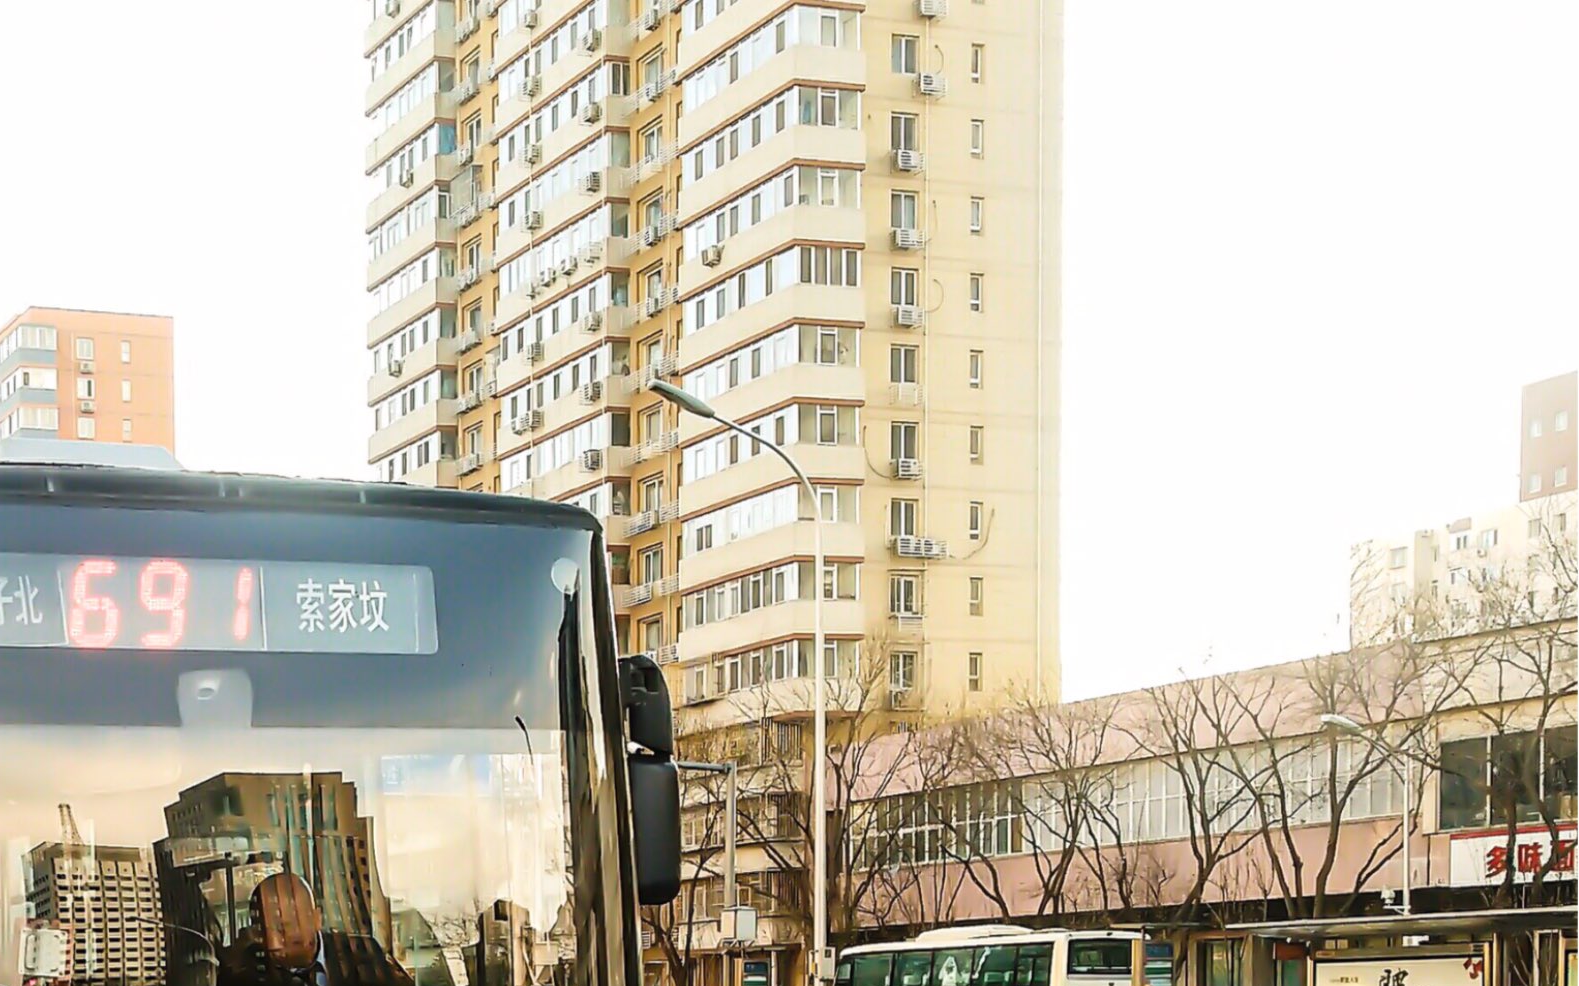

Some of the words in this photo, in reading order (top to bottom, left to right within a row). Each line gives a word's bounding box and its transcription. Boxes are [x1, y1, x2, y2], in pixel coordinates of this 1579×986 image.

[70, 558, 253, 647] 691
[296, 577, 390, 633] 索家坟
